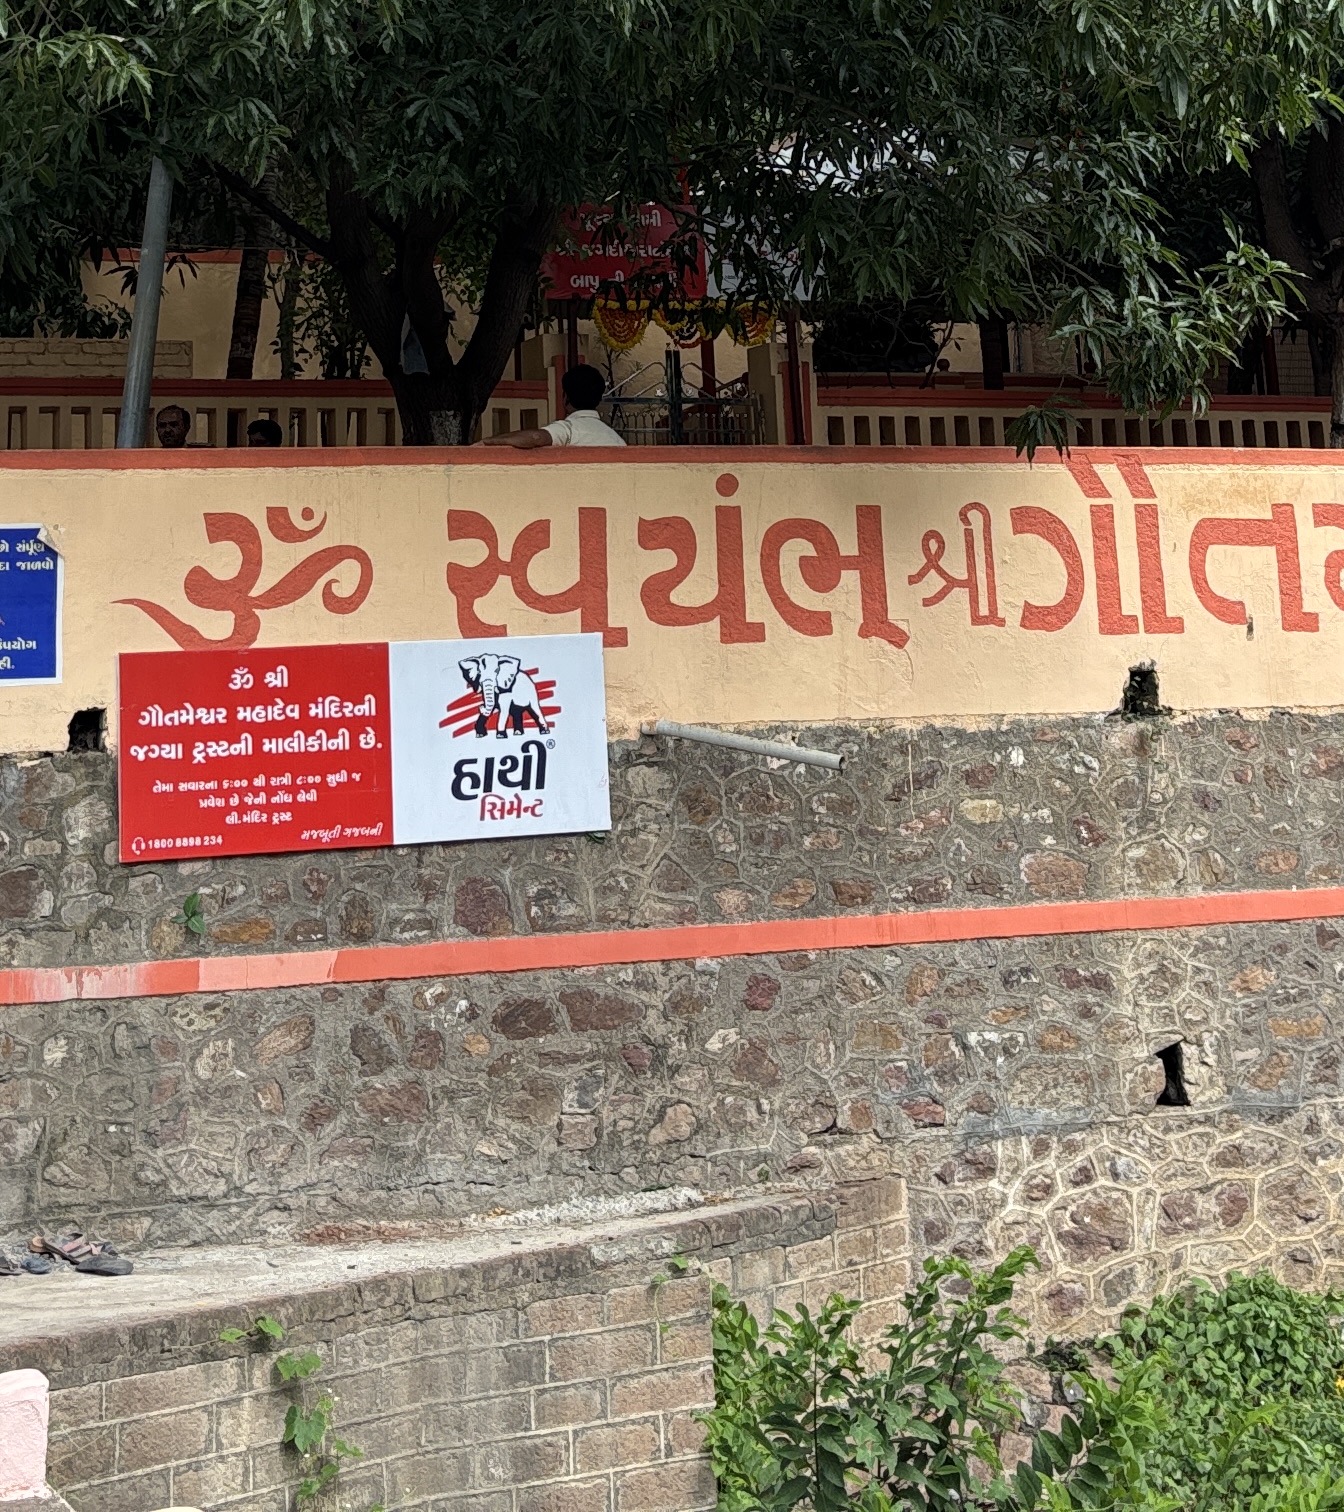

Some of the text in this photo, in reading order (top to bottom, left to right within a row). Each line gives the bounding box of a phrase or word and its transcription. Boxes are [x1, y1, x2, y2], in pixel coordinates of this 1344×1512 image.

[16, 557, 54, 570] જાળવો
[264, 665, 289, 688] શ્રી
[237, 698, 300, 723] મહાદેવ
[309, 694, 376, 718] મંદિરની
[130, 727, 383, 764] જગ્યા ટ્રસ્ટની માલીકીની છે.
[178, 779, 218, 792] સવારના
[326, 770, 348, 787] સુધી
[351, 772, 362, 782] જ
[451, 740, 547, 801] હાથી
[230, 793, 239, 807] છે
[243, 792, 266, 806] જેની
[297, 789, 317, 803] લેવી
[479, 793, 543, 821] સિમેન્ટ
[148, 838, 173, 850] 1800
